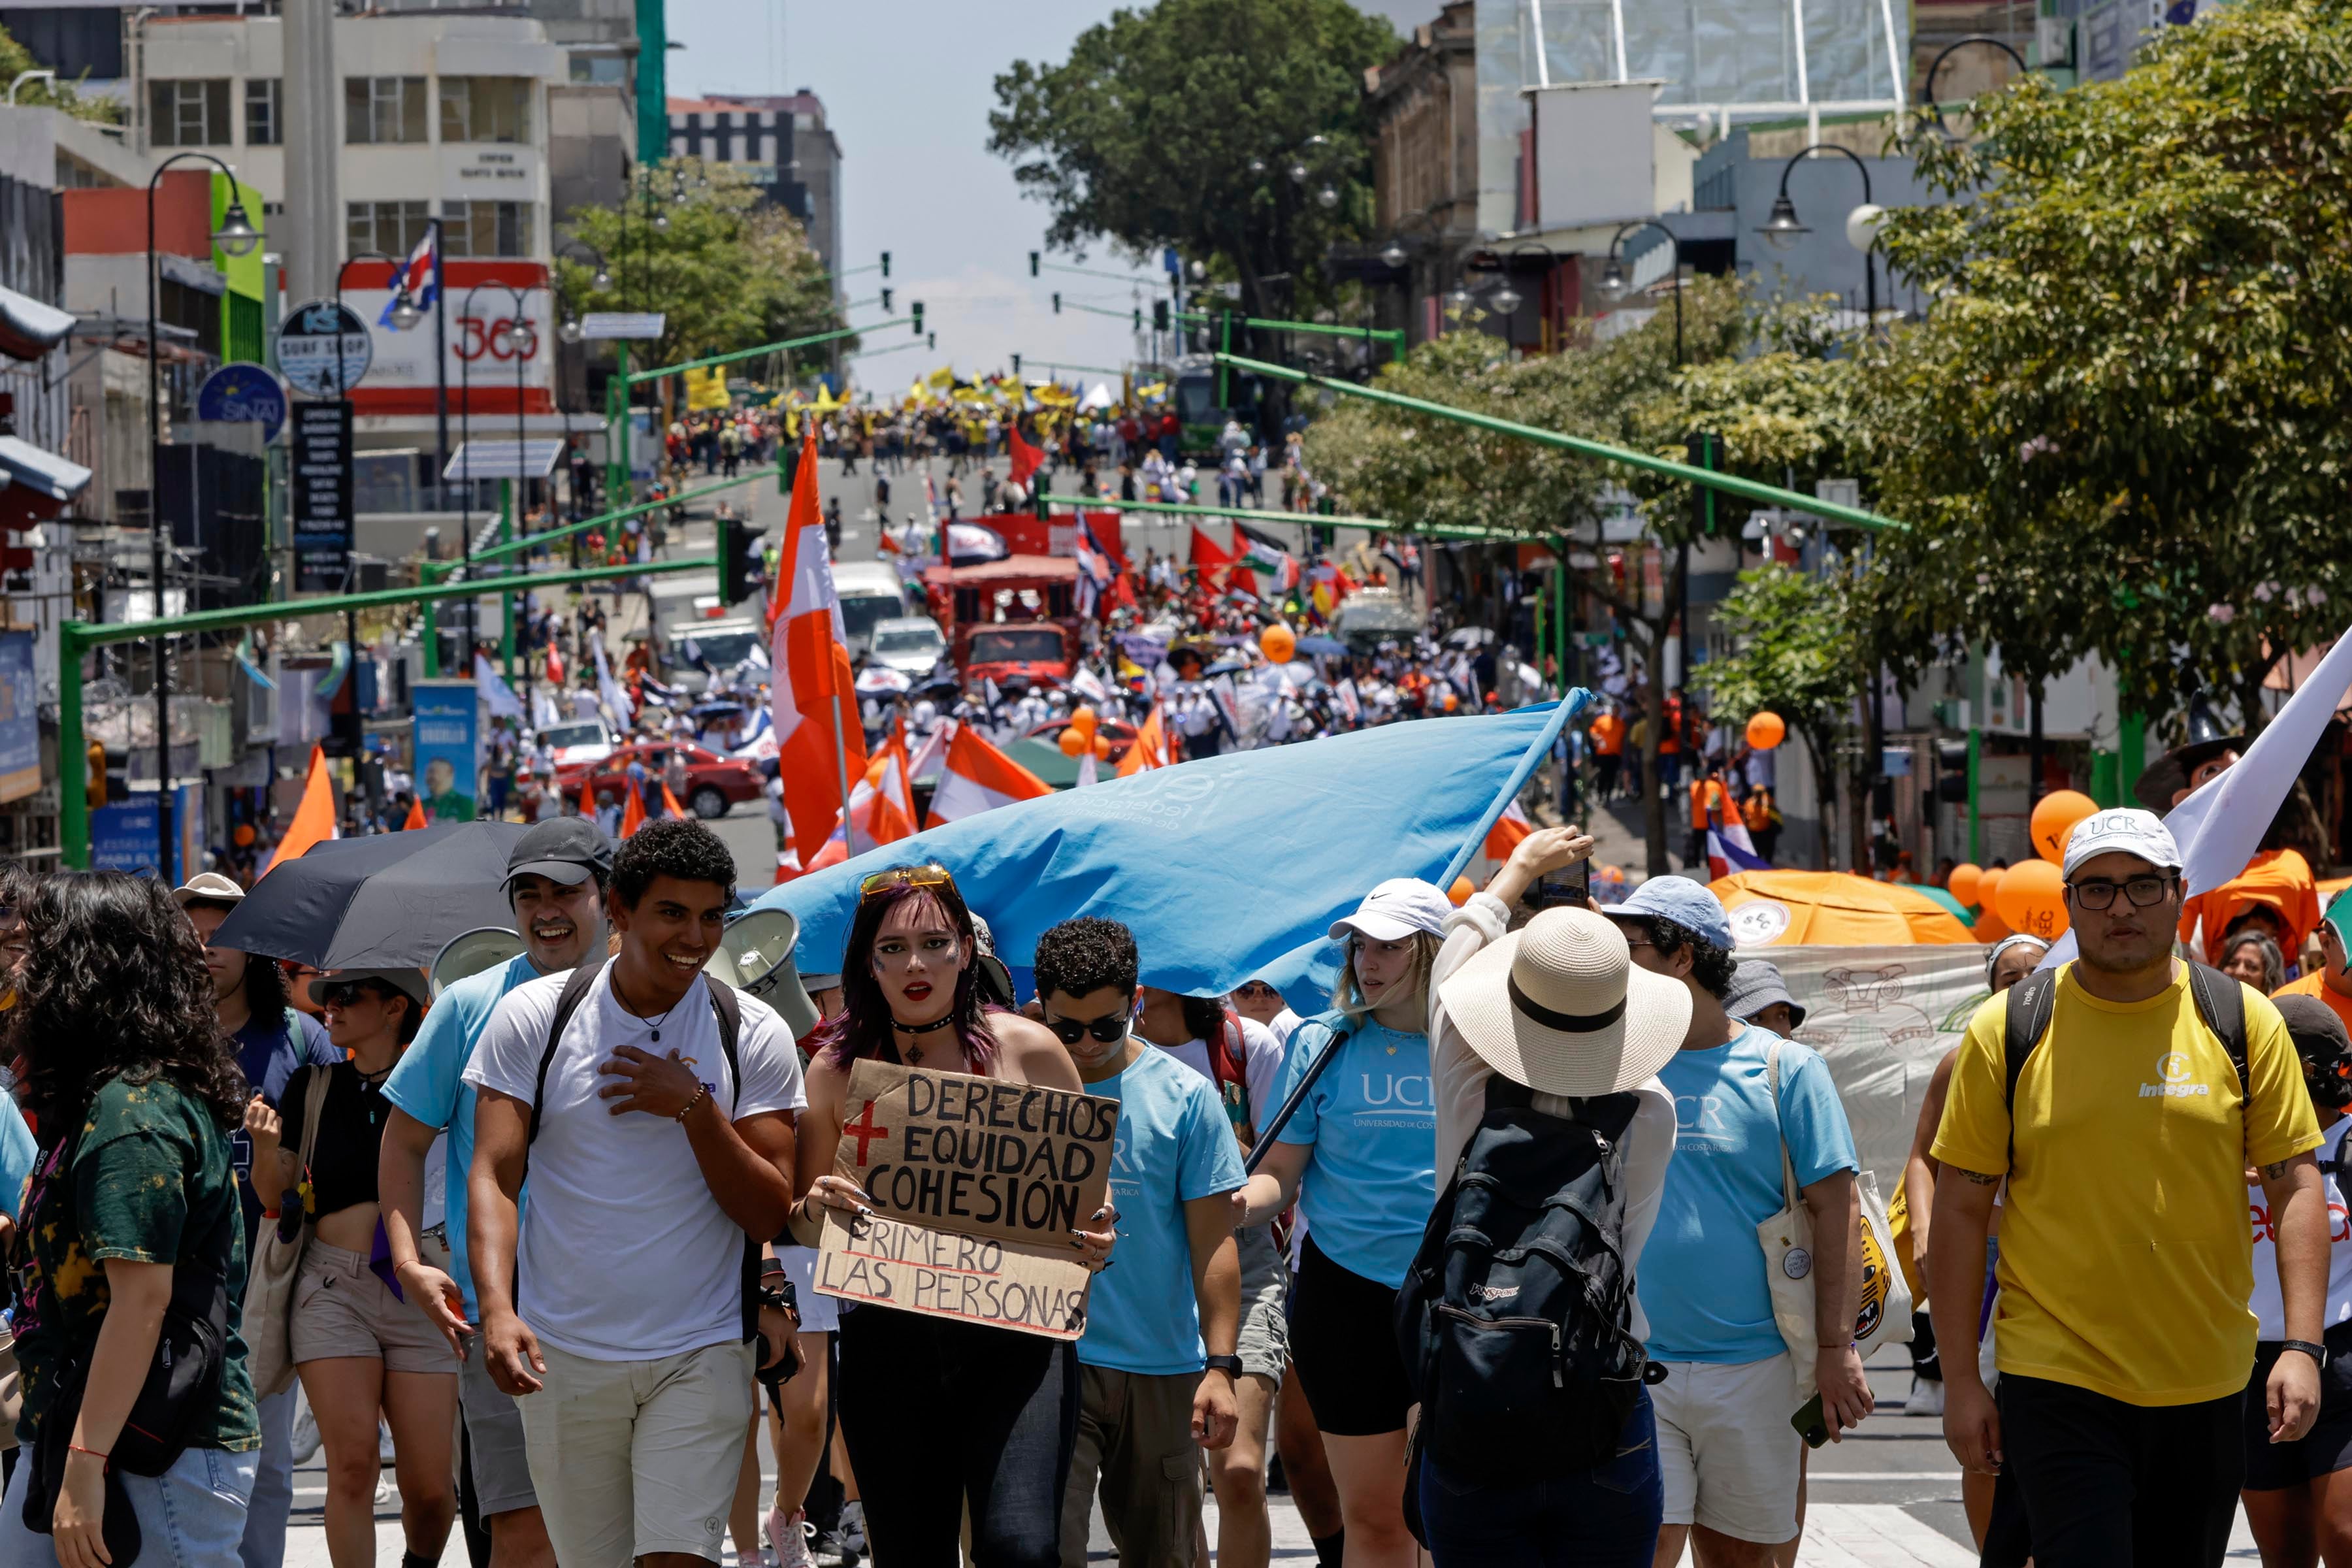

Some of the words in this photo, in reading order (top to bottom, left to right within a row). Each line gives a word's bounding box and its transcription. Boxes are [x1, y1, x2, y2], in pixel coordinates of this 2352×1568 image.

[2091, 815, 2139, 834] UCR
[908, 1073, 1118, 1142] DERECHOS
[1354, 1119, 1407, 1128] UNIVERSIDAD
[1675, 1096, 1726, 1130] CR
[904, 1126, 1095, 1183] EQUIDAD
[864, 1164, 1080, 1233] COHESIÓN
[847, 1216, 1003, 1273] PRIMERO
[823, 1252, 892, 1298] LAS
[915, 1268, 1085, 1332] PERSONAS
